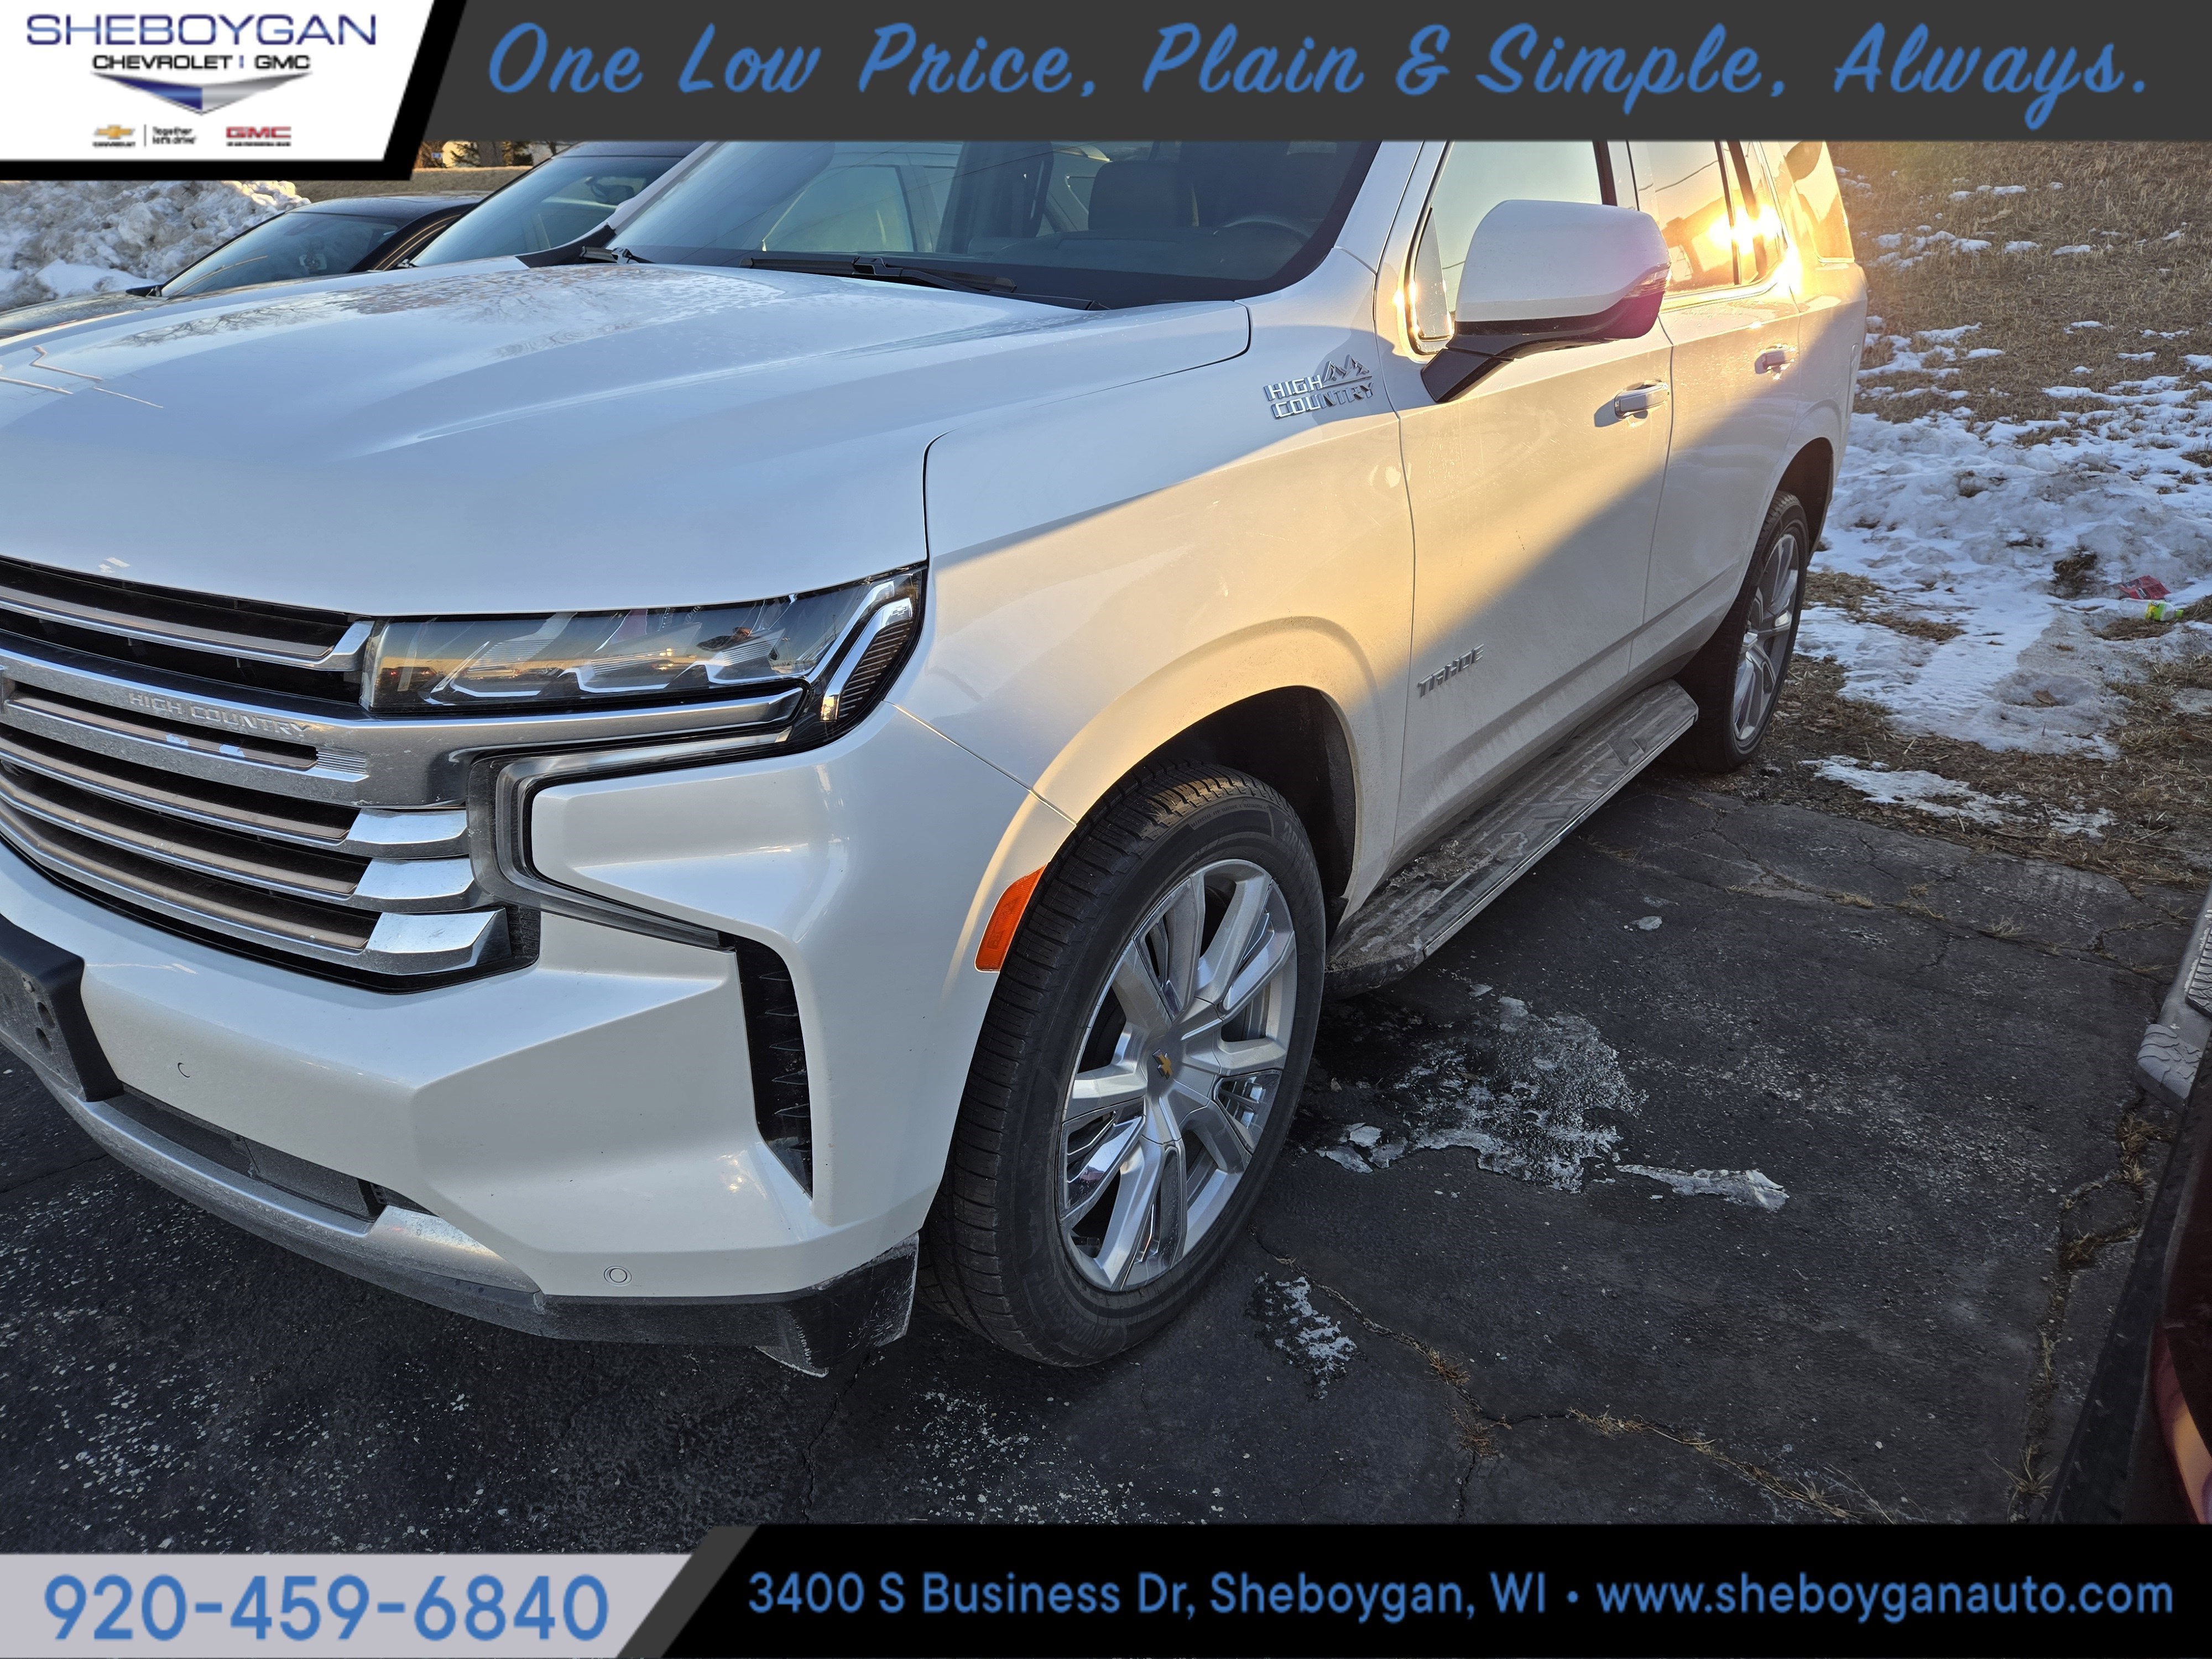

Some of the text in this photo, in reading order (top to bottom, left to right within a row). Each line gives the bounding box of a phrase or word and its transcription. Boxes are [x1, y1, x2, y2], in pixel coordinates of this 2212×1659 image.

[1264, 374, 1323, 401] HIGH
[1271, 382, 1374, 419] COUNTRY
[1417, 643, 1484, 698] TAHOE
[129, 692, 310, 737] HIGH COUNTRY
